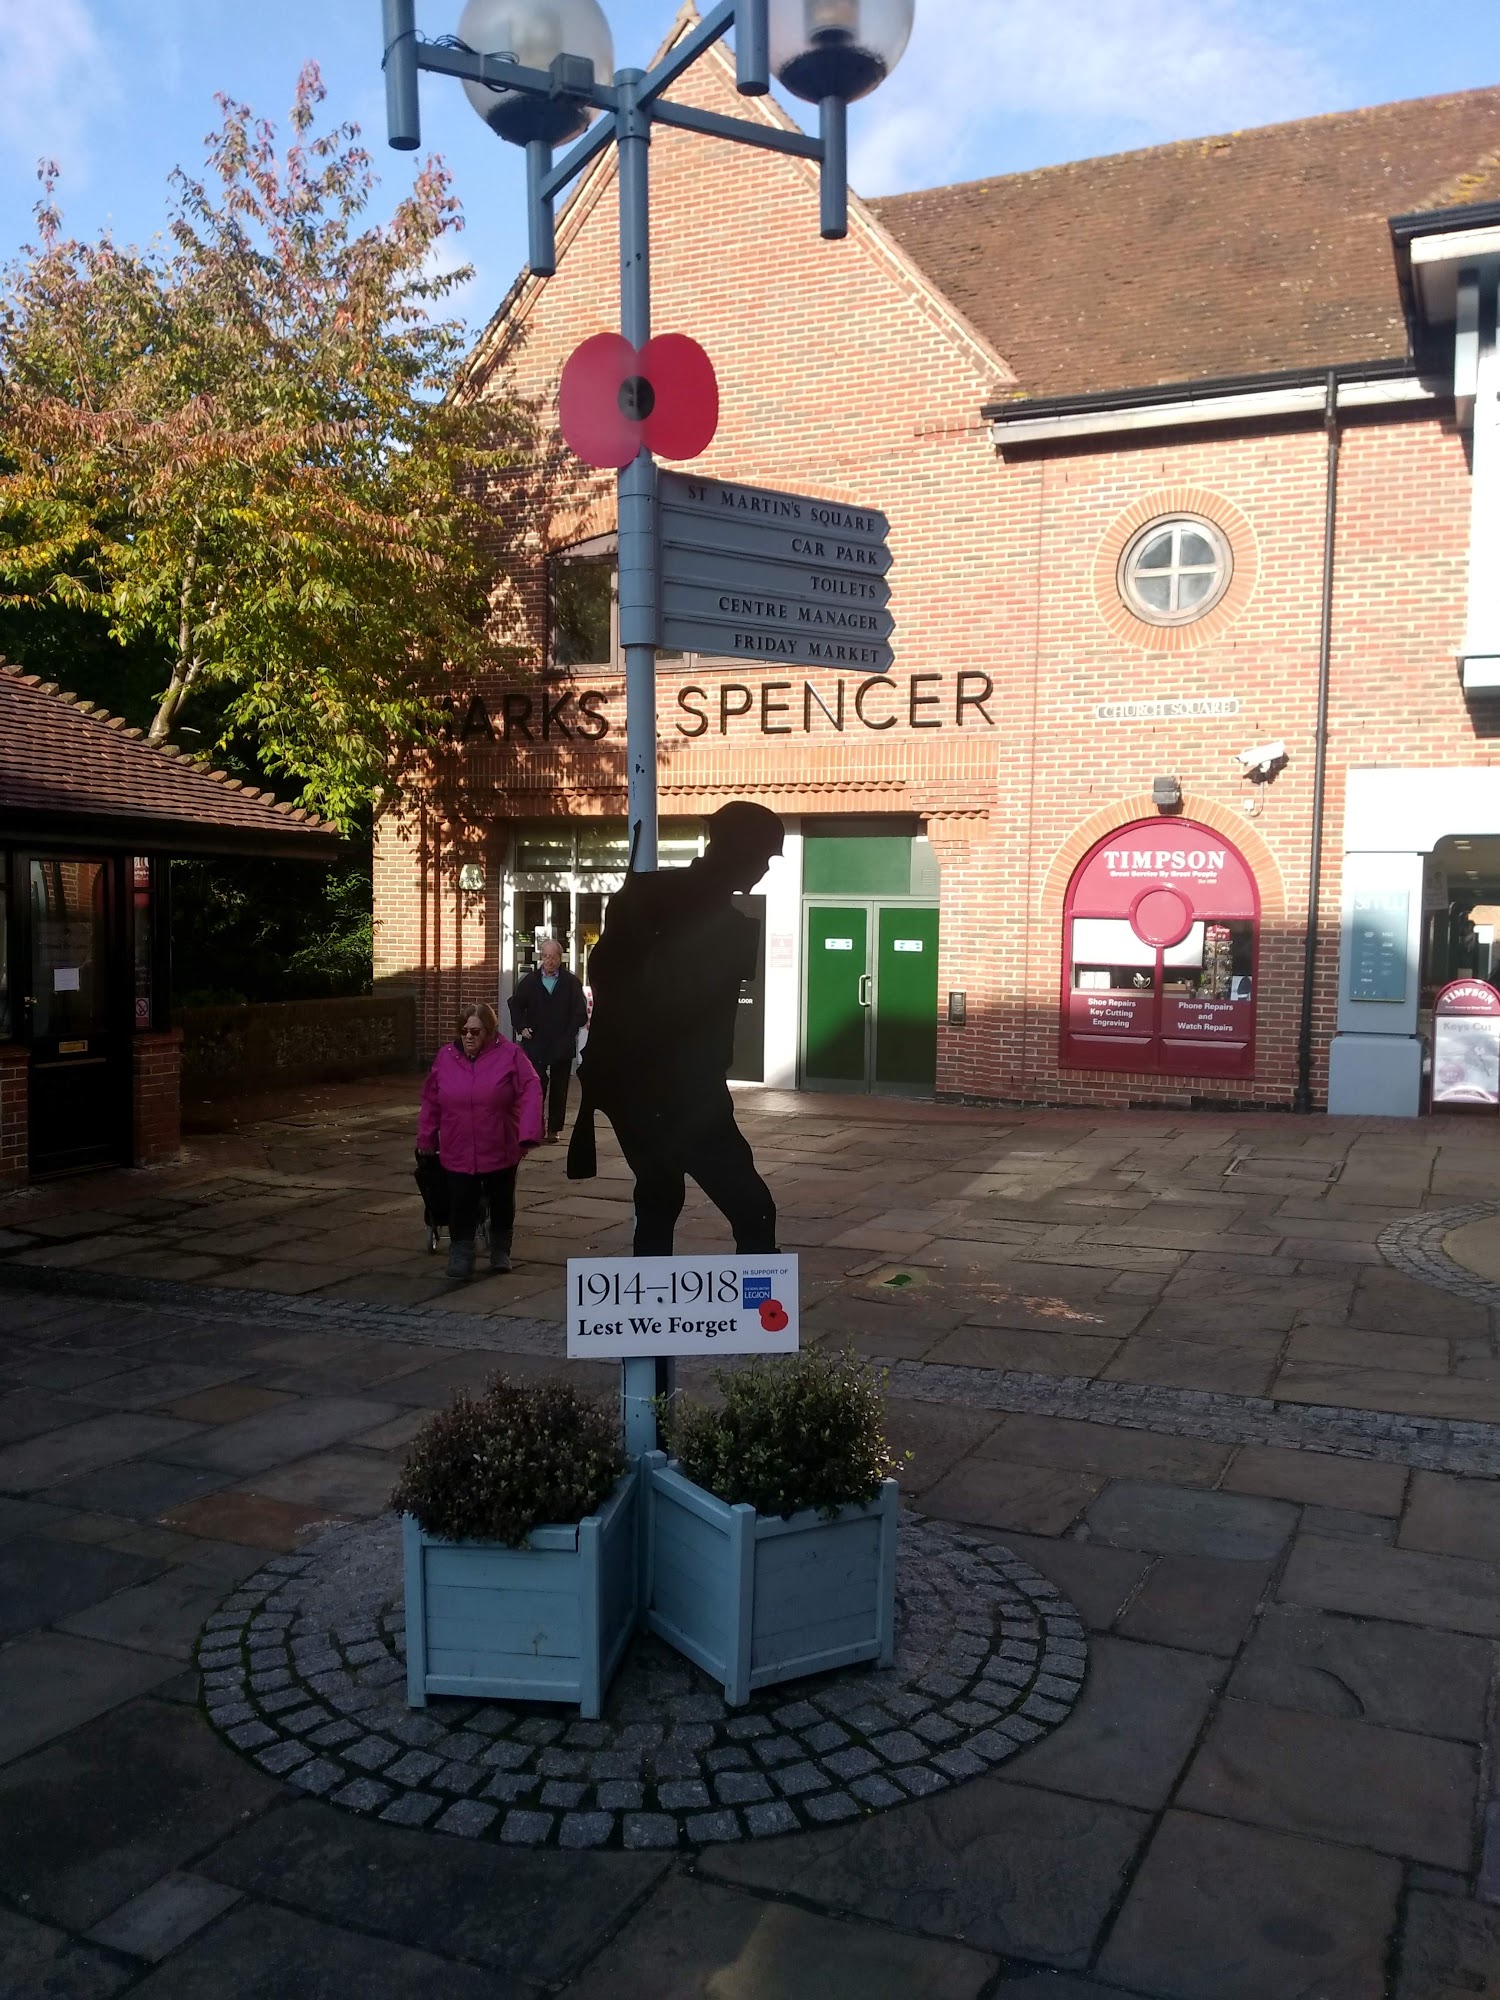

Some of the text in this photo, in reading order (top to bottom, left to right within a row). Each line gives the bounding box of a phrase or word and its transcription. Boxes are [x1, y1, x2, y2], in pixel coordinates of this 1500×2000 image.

[688, 484, 875, 532] ST MARTIN'S SQUARE
[791, 538, 878, 565] CAR PARK
[810, 576, 876, 598] TOILETS
[718, 596, 878, 630] CENTRE MANAGER
[733, 633, 879, 663] FRIDAY MARKET
[675, 670, 996, 737] SPENCER
[1103, 701, 1231, 718] CHURCH SQUARE
[1103, 850, 1226, 869] TIMPSON
[1088, 998, 1136, 1008] Shoe Repairs
[1442, 987, 1497, 1005] TIMPSON
[1090, 1008, 1133, 1018] Key Cutting
[1178, 1001, 1234, 1012] Phone Repairs
[1093, 1018, 1130, 1028] Engraving
[1177, 1022, 1233, 1032] Watch Repairs
[1443, 1022, 1492, 1032] Keys Cut
[744, 1291, 770, 1299] LEGION
[577, 1316, 738, 1338] Lest We Forget
